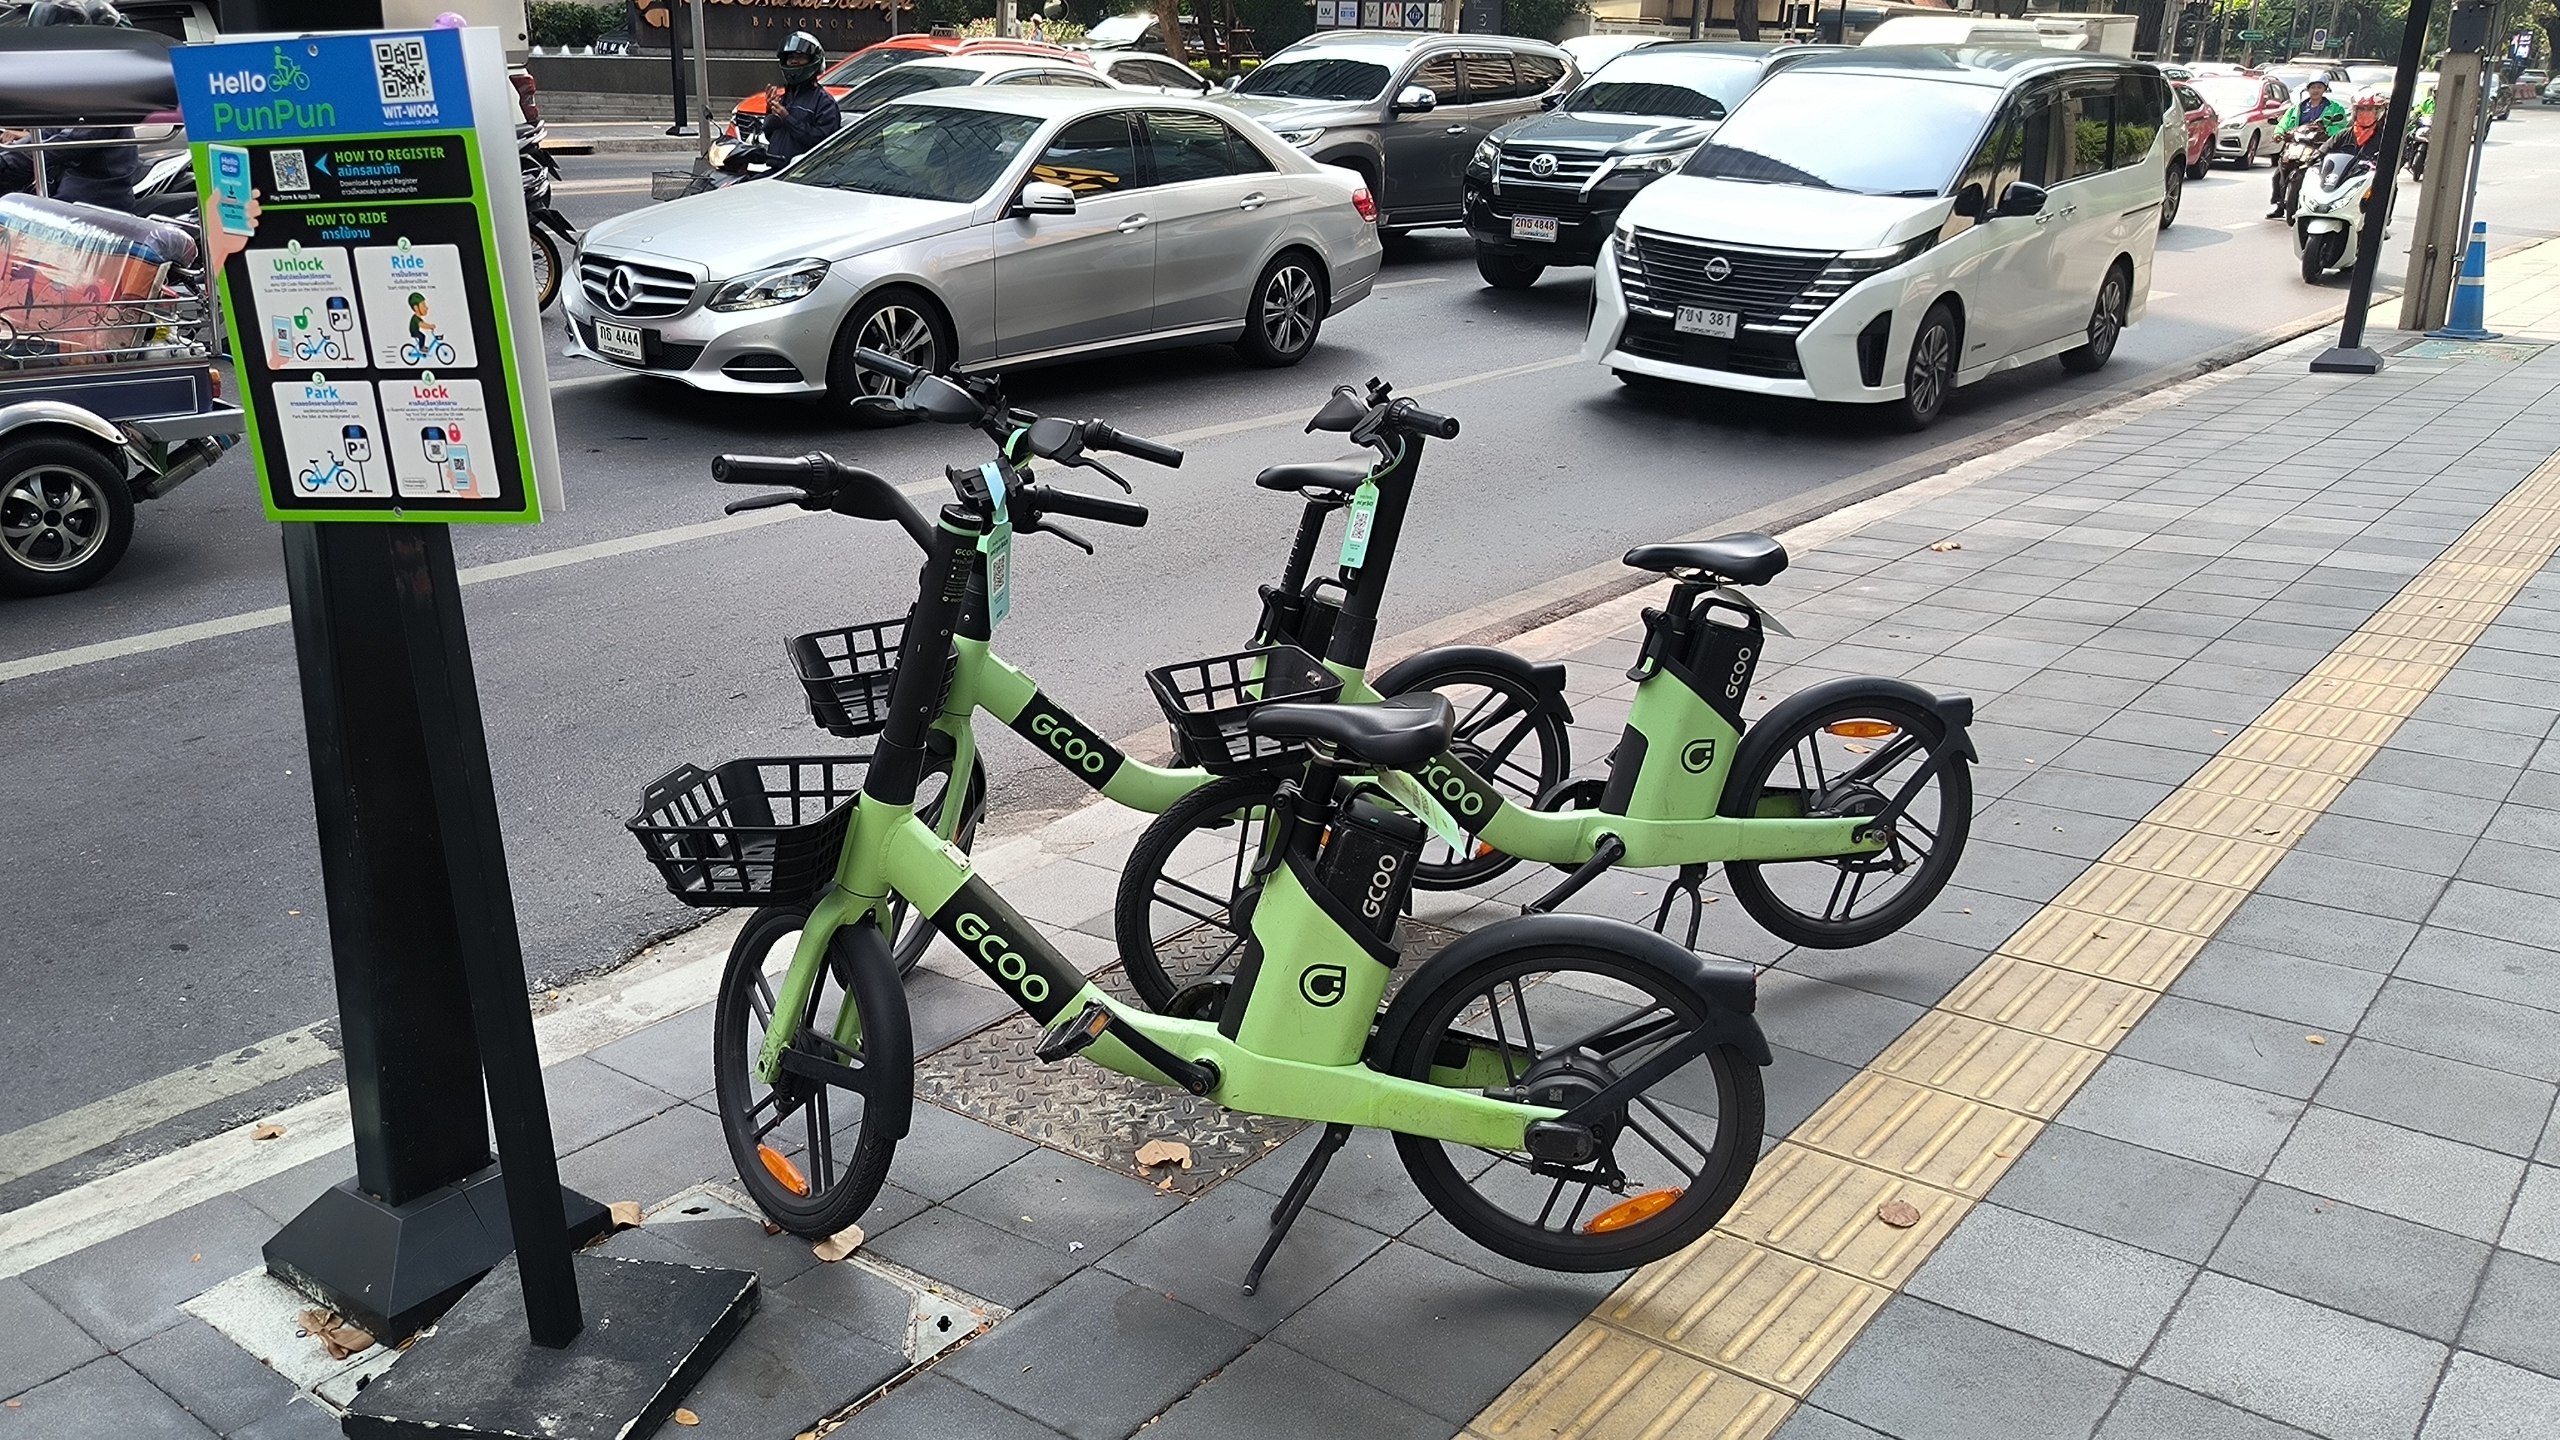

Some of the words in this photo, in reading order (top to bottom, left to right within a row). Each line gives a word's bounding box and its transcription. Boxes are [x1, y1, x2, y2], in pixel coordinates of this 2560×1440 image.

[752, 16, 854, 29] BANGKOK
[208, 70, 267, 95] Hello
[213, 99, 336, 132] PunPun
[382, 104, 439, 119] WIT-W004
[334, 151, 364, 162] HOW
[368, 150, 384, 161] TO
[387, 147, 445, 160] REGISTER
[338, 163, 400, 177] สมัครสมาชิก
[306, 214, 336, 226] HOW
[339, 213, 356, 224] TO
[358, 212, 388, 224] RIDE
[1534, 220, 1554, 230] 4848
[322, 226, 370, 240] การใช้งาน
[400, 240, 408, 250] 2
[273, 257, 324, 272] Unlock
[391, 255, 424, 269] Ride
[1709, 312, 1731, 328] 381
[616, 330, 639, 347] 4444
[316, 374, 323, 384] 3
[425, 372, 432, 383] 4
[305, 386, 339, 398] Park
[413, 384, 449, 398] Lock
[1725, 647, 1752, 700] GCOO
[1032, 713, 1104, 773] GCOO
[1362, 854, 1397, 918] GCOO
[955, 912, 1050, 1002] GCOO
